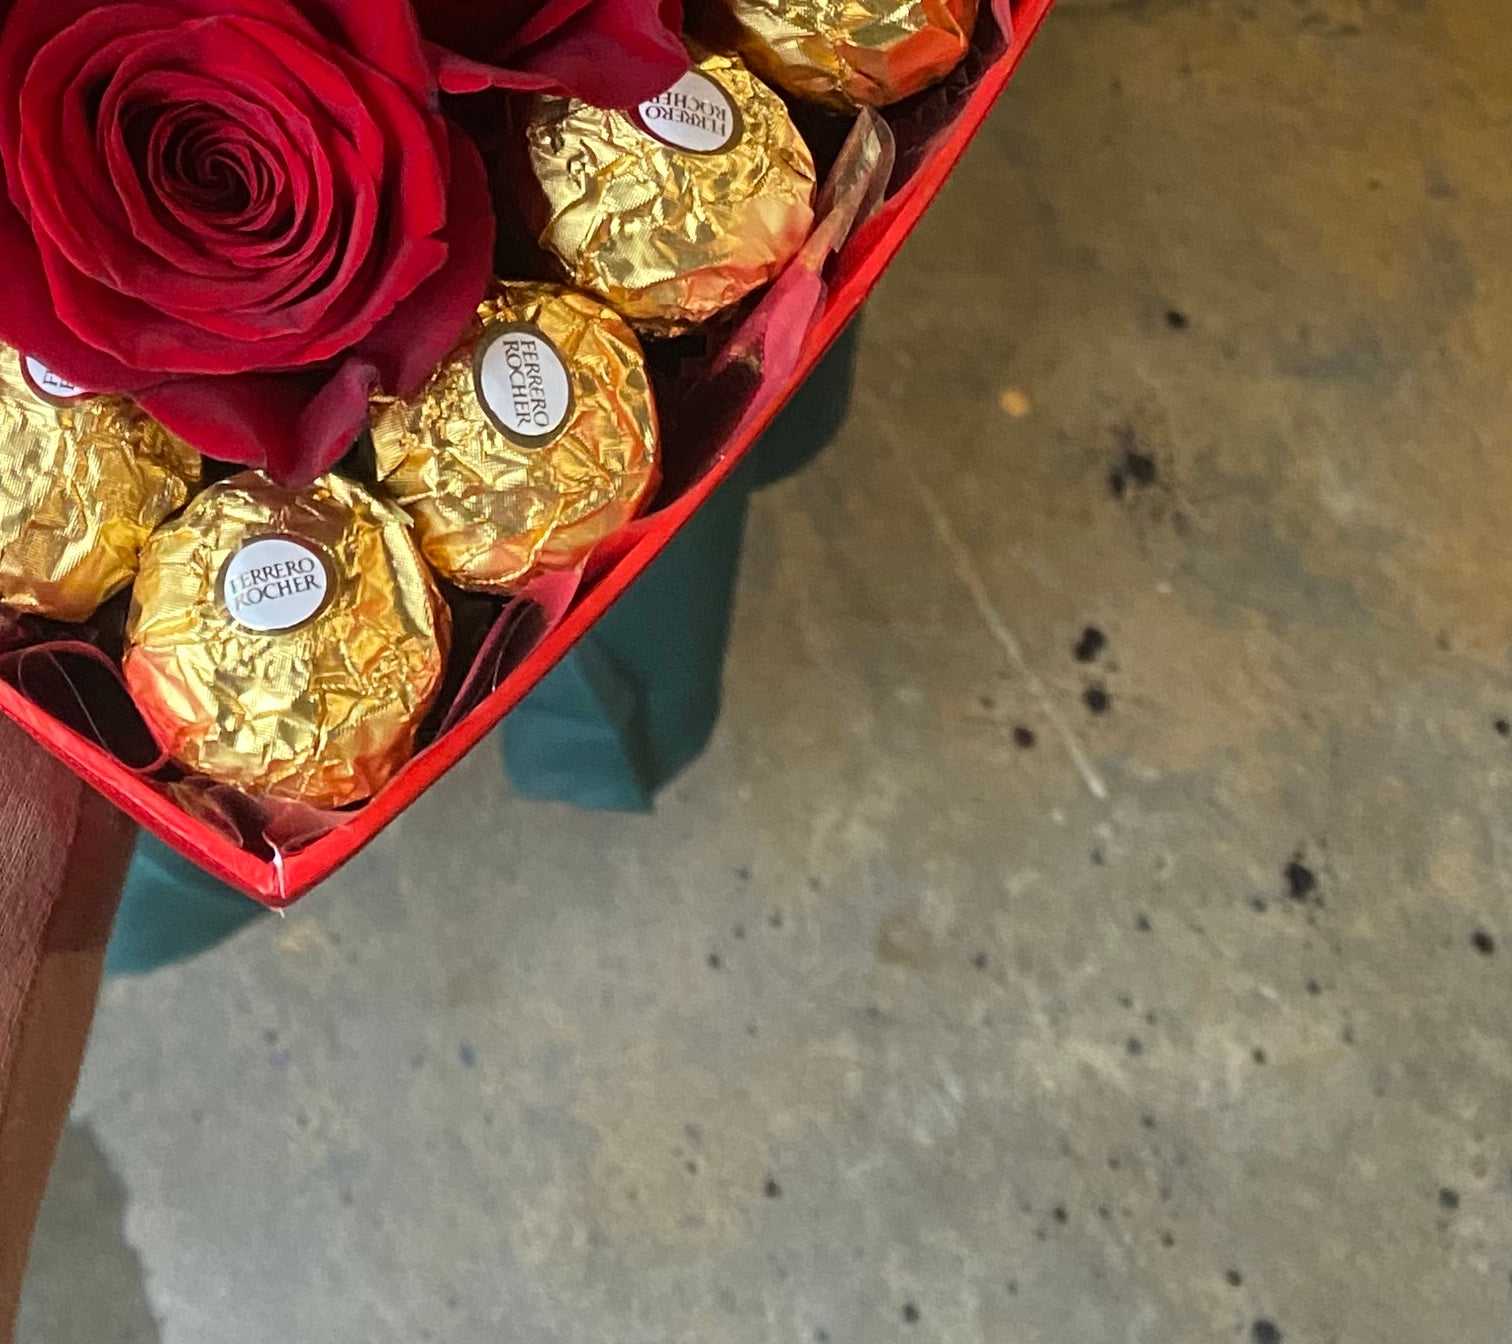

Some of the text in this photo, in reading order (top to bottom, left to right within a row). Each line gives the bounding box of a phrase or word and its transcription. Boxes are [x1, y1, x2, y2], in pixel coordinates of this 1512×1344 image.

[645, 105, 726, 137] FERRERO
[503, 340, 531, 427] ROCHER
[521, 340, 549, 427] FERRERO
[230, 557, 315, 594] FERRERO
[235, 574, 321, 611] ROCHER
